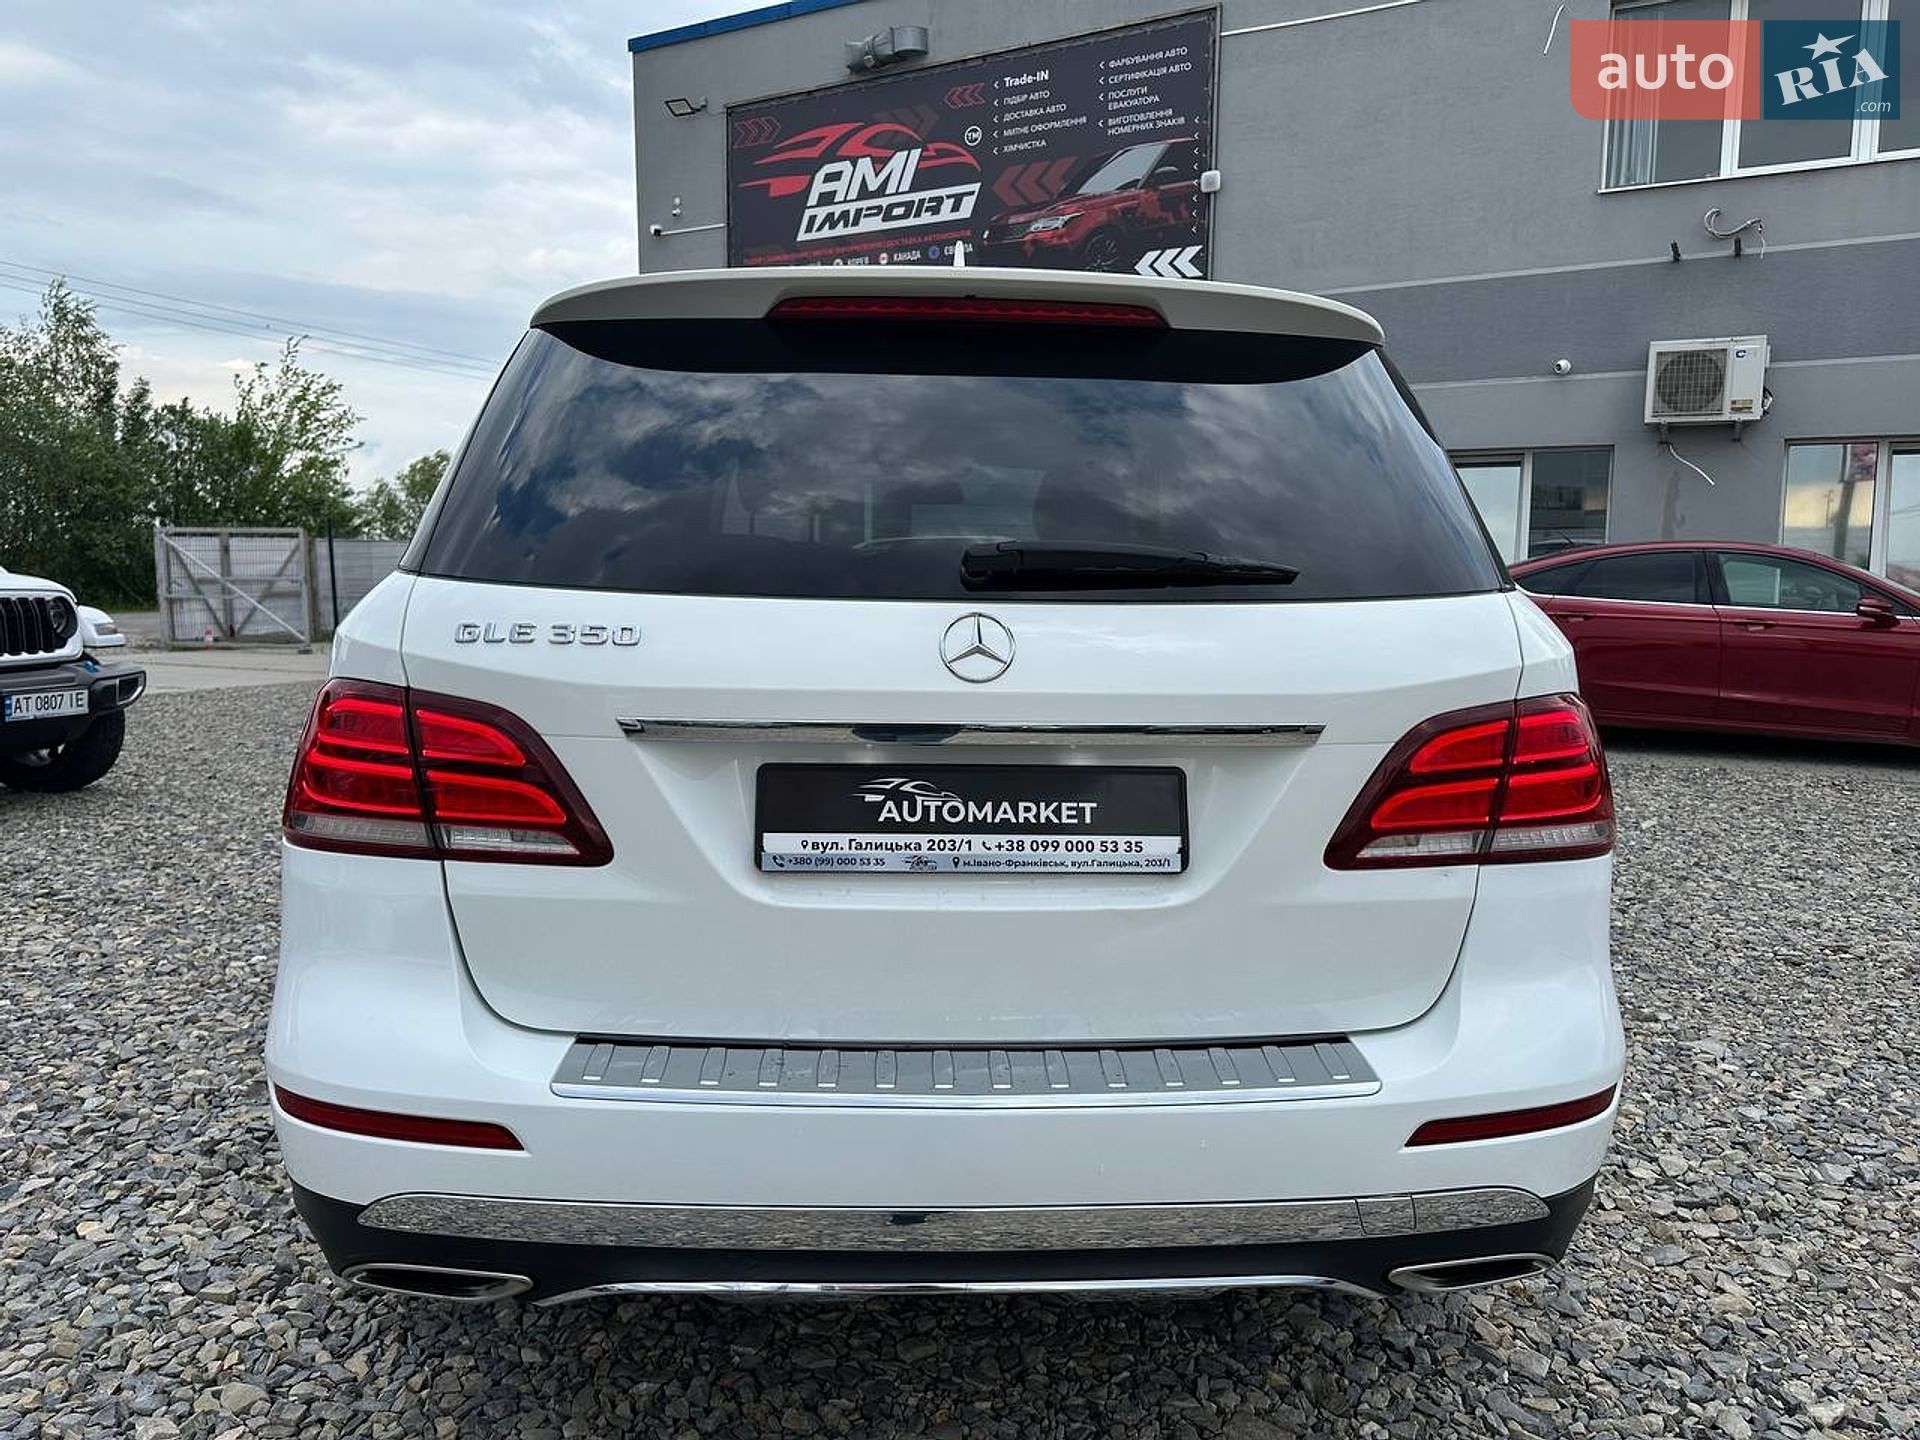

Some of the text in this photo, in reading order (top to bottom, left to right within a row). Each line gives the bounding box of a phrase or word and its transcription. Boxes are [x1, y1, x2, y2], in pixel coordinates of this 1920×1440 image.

[1165, 46, 1188, 58] АВТО
[1169, 62, 1192, 73] АВТО
[1004, 70, 1049, 87] Trade-IN
[1029, 90, 1050, 101] АВТО
[1004, 103, 1067, 122] ДОСТАВКА АВТО
[806, 148, 922, 206] AMI
[804, 190, 976, 234] IMPORT
[944, 243, 973, 256] ЄВПА
[454, 622, 642, 647] GLE 350
[13, 691, 85, 714] AT 0807 IE
[877, 800, 1098, 823] AUTOMARKET
[811, 838, 1144, 854] вул. Галицька 203/1 +38 099 000 53 35
[788, 856, 812, 866] +380
[814, 855, 835, 868] (99)
[836, 856, 857, 866] 000
[859, 856, 871, 866] 53
[872, 857, 886, 867] 35
[1145, 859, 1170, 868] 203/1
